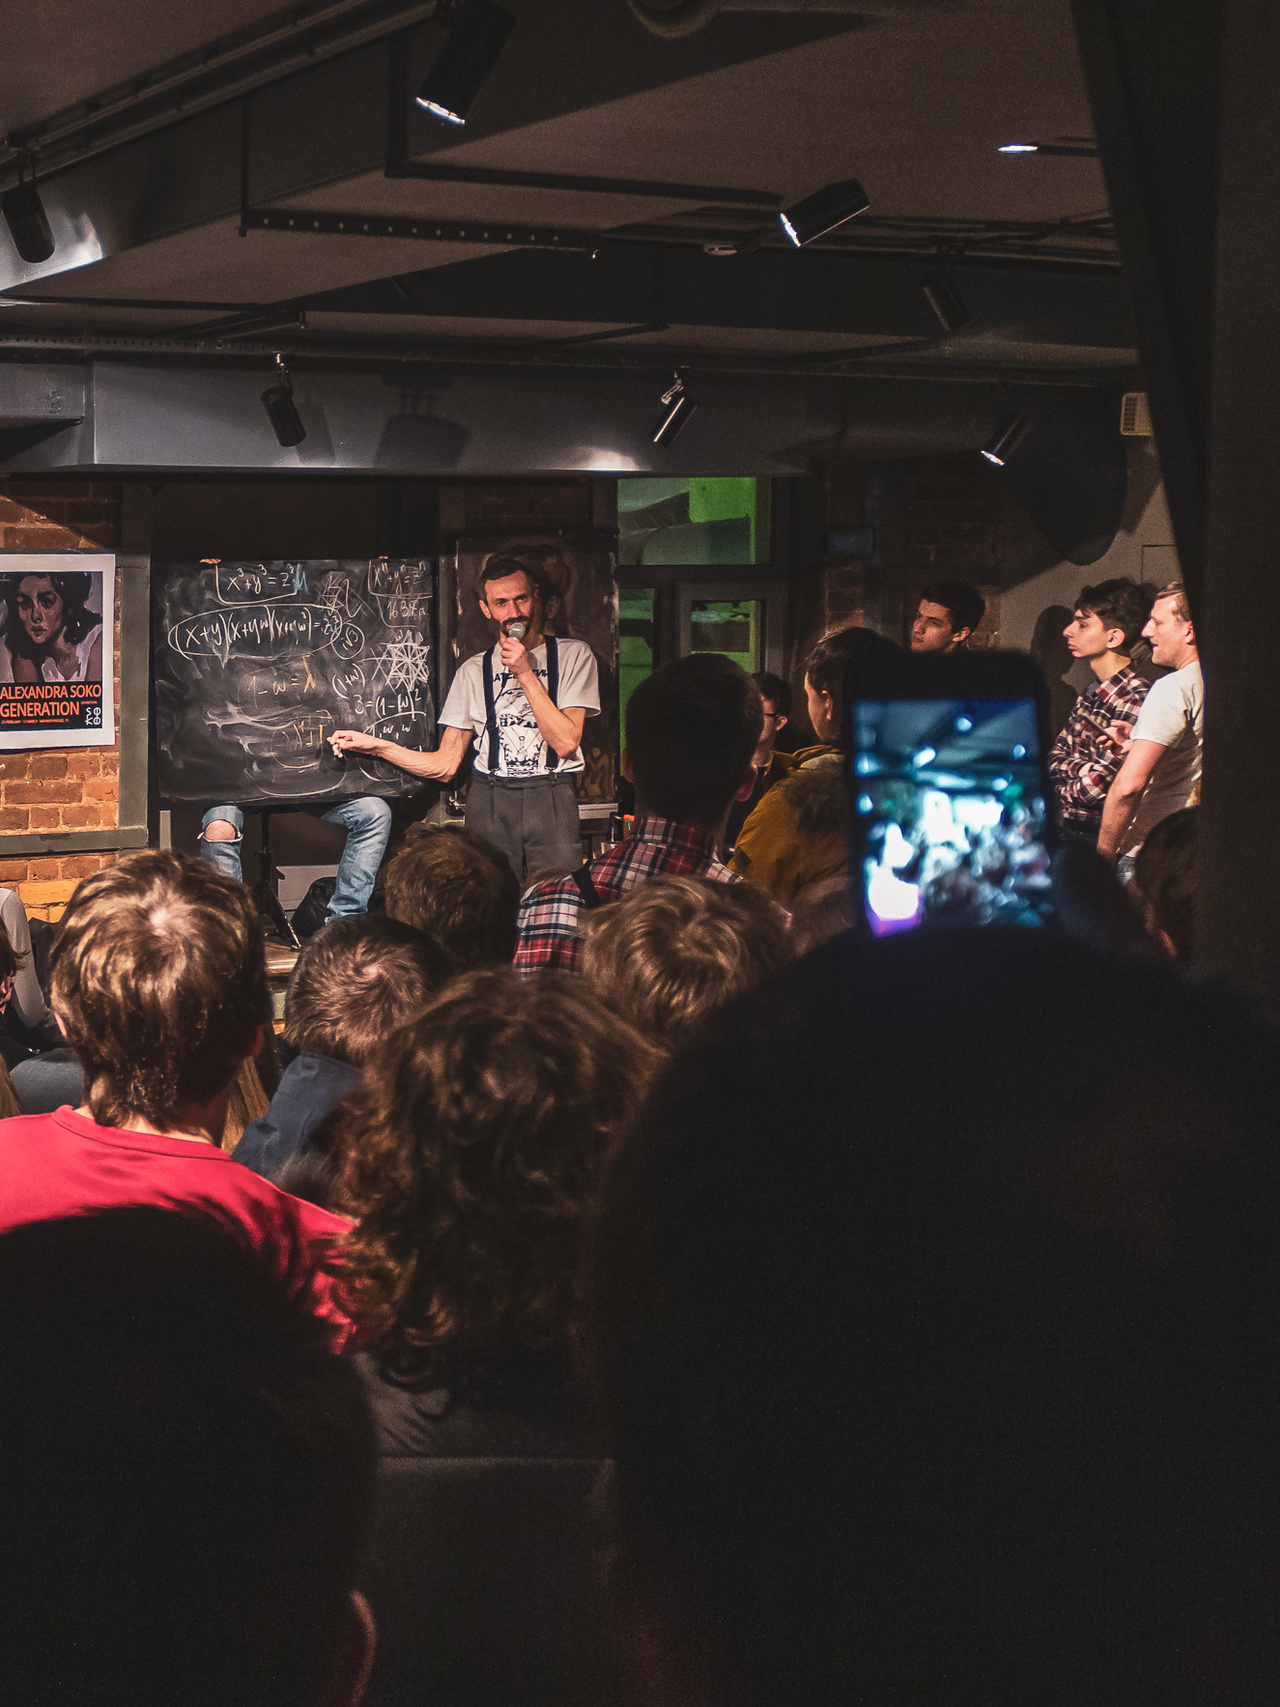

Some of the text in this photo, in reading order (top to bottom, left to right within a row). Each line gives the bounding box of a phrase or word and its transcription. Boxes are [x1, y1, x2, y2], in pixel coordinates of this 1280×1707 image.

[0, 684, 102, 700] ALEXANDRA SOKO
[0, 701, 79, 718] GENERATION
